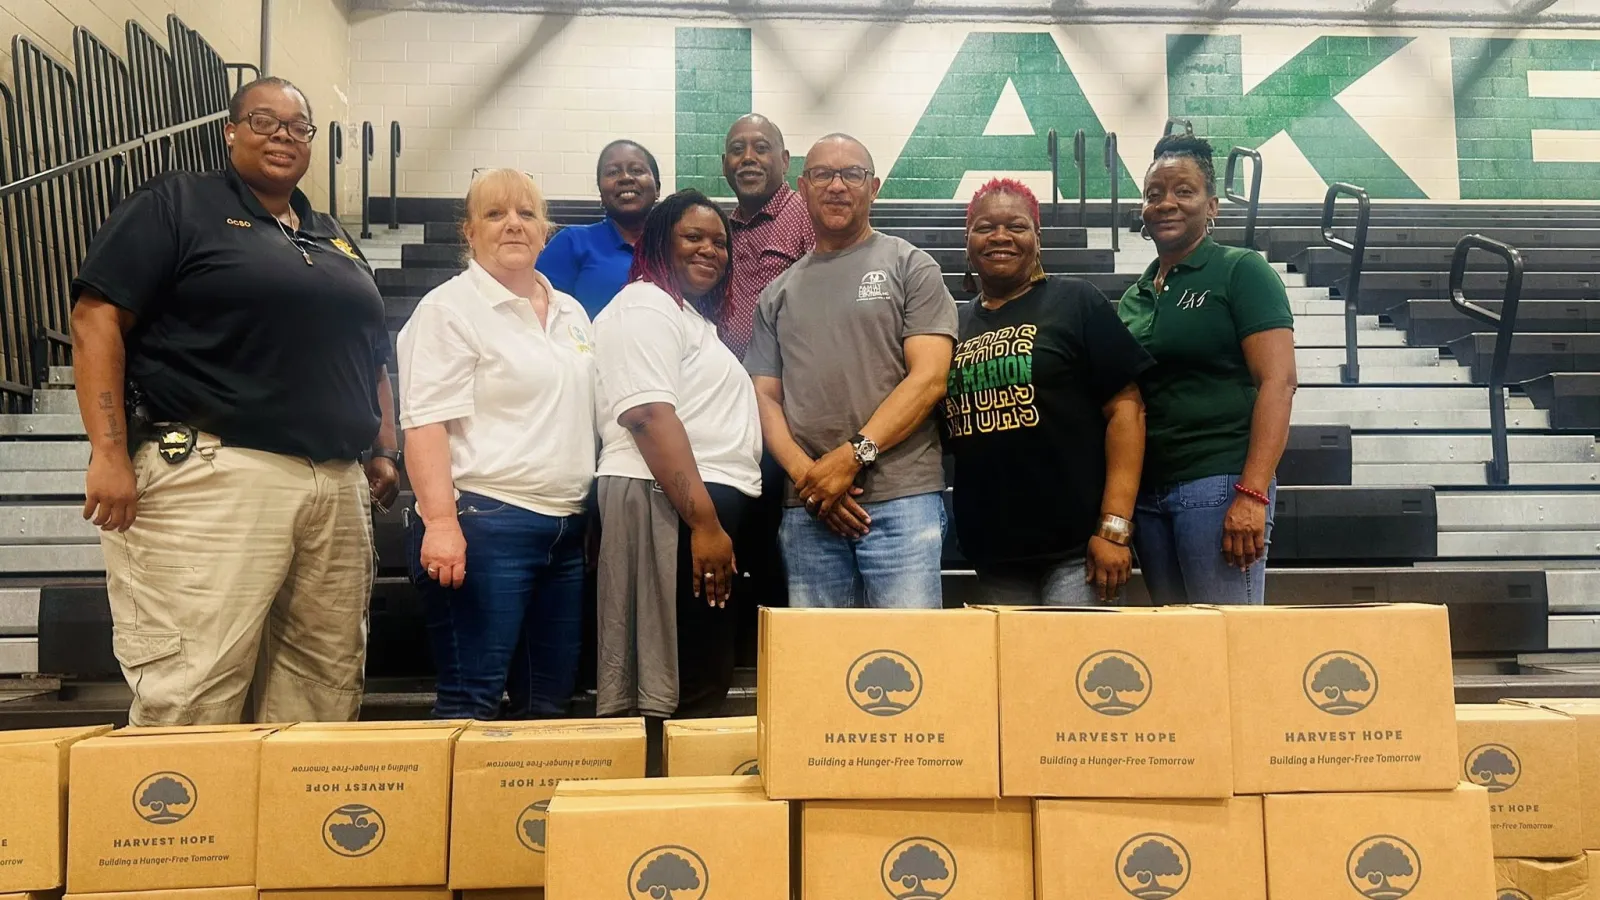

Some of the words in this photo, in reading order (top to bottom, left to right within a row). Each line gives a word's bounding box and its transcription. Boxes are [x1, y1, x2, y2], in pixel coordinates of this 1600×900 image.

[675, 27, 1600, 199] LAKE
[226, 218, 251, 228] OCSO
[962, 355, 1033, 393] MARION
[825, 732, 898, 744] HARVEST
[904, 732, 945, 744] HOPE
[1056, 731, 1129, 743] HARVEST
[1134, 732, 1176, 743] HOPE
[1285, 731, 1356, 743] HARVEST
[1362, 729, 1403, 741] HOPE
[485, 760, 525, 769] Tomorrow
[525, 758, 574, 769] Hunger-Free
[581, 758, 613, 768] Building
[807, 756, 847, 769] Building
[856, 756, 915, 769] Hunger-Free
[916, 756, 964, 767] Tomorrow
[1039, 755, 1078, 767] Building
[1087, 755, 1147, 767] Hunger-Free
[1148, 756, 1195, 766] Tomorrow
[1269, 755, 1308, 767] Building
[1317, 754, 1375, 766] Hunger-Free
[1376, 753, 1422, 764] Tomorrow
[291, 764, 330, 774] Tomorrow
[331, 763, 380, 773] Hunger-Free
[387, 763, 419, 773] Building
[305, 783, 340, 794] HOPE
[344, 782, 405, 793] HARVEST
[500, 778, 534, 788] HOPE
[1508, 804, 1539, 813] HOPE
[1491, 822, 1518, 830] er-Free
[1518, 822, 1554, 830] Tomorrow
[113, 836, 175, 848] HARVEST
[180, 835, 216, 846] HOPE
[0, 858, 24, 866] orrow
[98, 857, 132, 868] Building
[139, 855, 189, 866] Hunger-Free
[190, 854, 230, 863] Tomorrow
